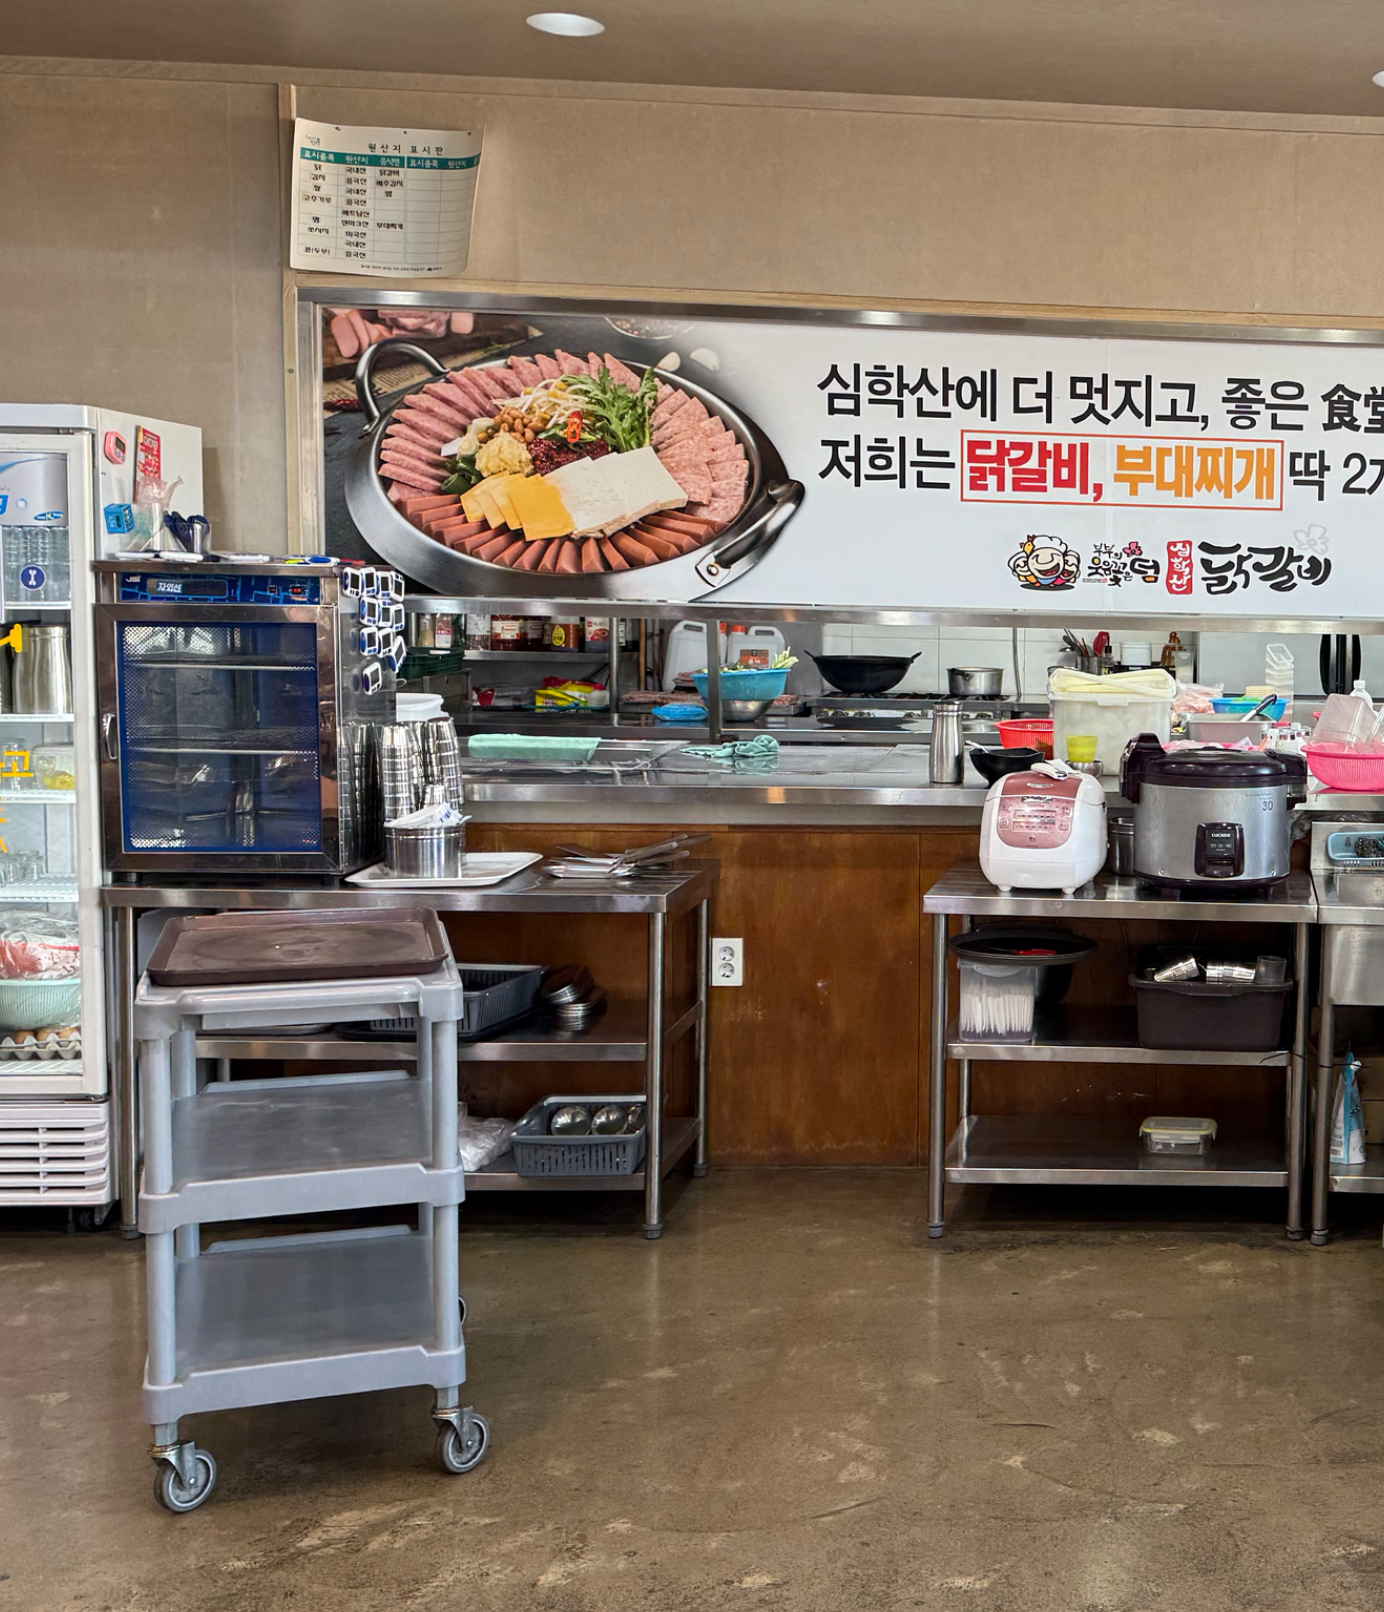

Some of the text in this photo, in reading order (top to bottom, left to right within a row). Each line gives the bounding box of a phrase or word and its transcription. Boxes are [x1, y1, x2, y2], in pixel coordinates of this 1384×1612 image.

[345, 155, 368, 165] 원산지
[817, 363, 997, 422] 심학산에
[1012, 371, 1053, 424] 더
[1070, 373, 1208, 431] 멋지고,
[1221, 377, 1309, 431] 좋은
[818, 434, 956, 489] 저희는
[966, 440, 1103, 502] 닭갈비,
[1113, 446, 1276, 500] 부대찌개
[1289, 450, 1330, 501] 딱
[1197, 541, 1331, 596] 닭갈비
[1262, 801, 1273, 812] 30
